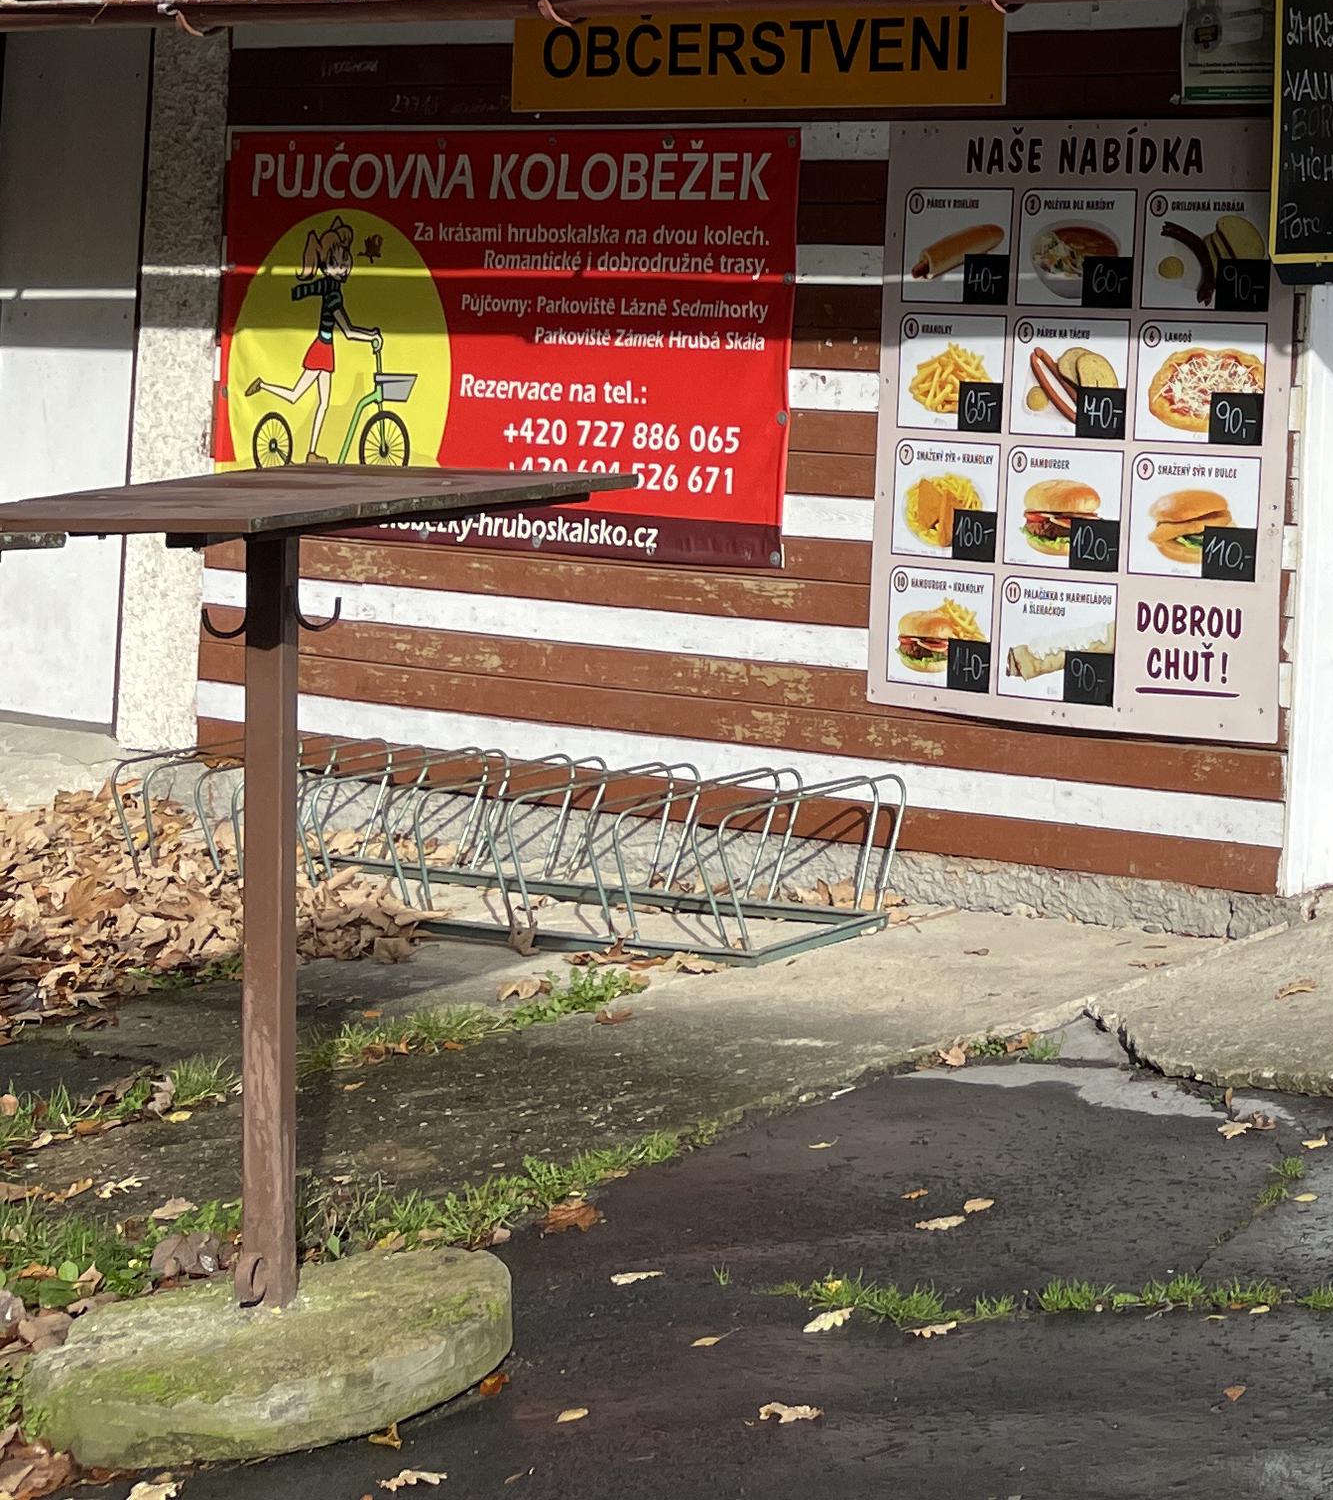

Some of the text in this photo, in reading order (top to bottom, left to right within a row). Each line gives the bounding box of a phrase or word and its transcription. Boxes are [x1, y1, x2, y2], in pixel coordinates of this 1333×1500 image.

[543, 5, 970, 79] OBČERSTVENÍ
[966, 127, 1203, 177] NAŠE NABÍDKA
[252, 139, 773, 200] PŮJČOVNA KOLOBĚŽEK
[414, 222, 770, 246] Za krásami hruboskalska na dvou kolech.
[484, 250, 770, 280] Romantické i dobrodružné trasy.
[462, 294, 769, 323] Půjčovny: Parkoviště Lázně Sedmihorky
[535, 326, 766, 351] Parkoviště Zámek Hrubá Skála
[460, 373, 648, 406] Rezervace na tel.:
[965, 391, 996, 424] 65,-
[1216, 401, 1256, 438] 90,-
[503, 418, 741, 454] +420 727 886 065
[631, 464, 734, 494] 526 671
[1073, 526, 1117, 561] 120,-
[1206, 535, 1253, 568] 110,-
[1137, 601, 1242, 638] DOBROU
